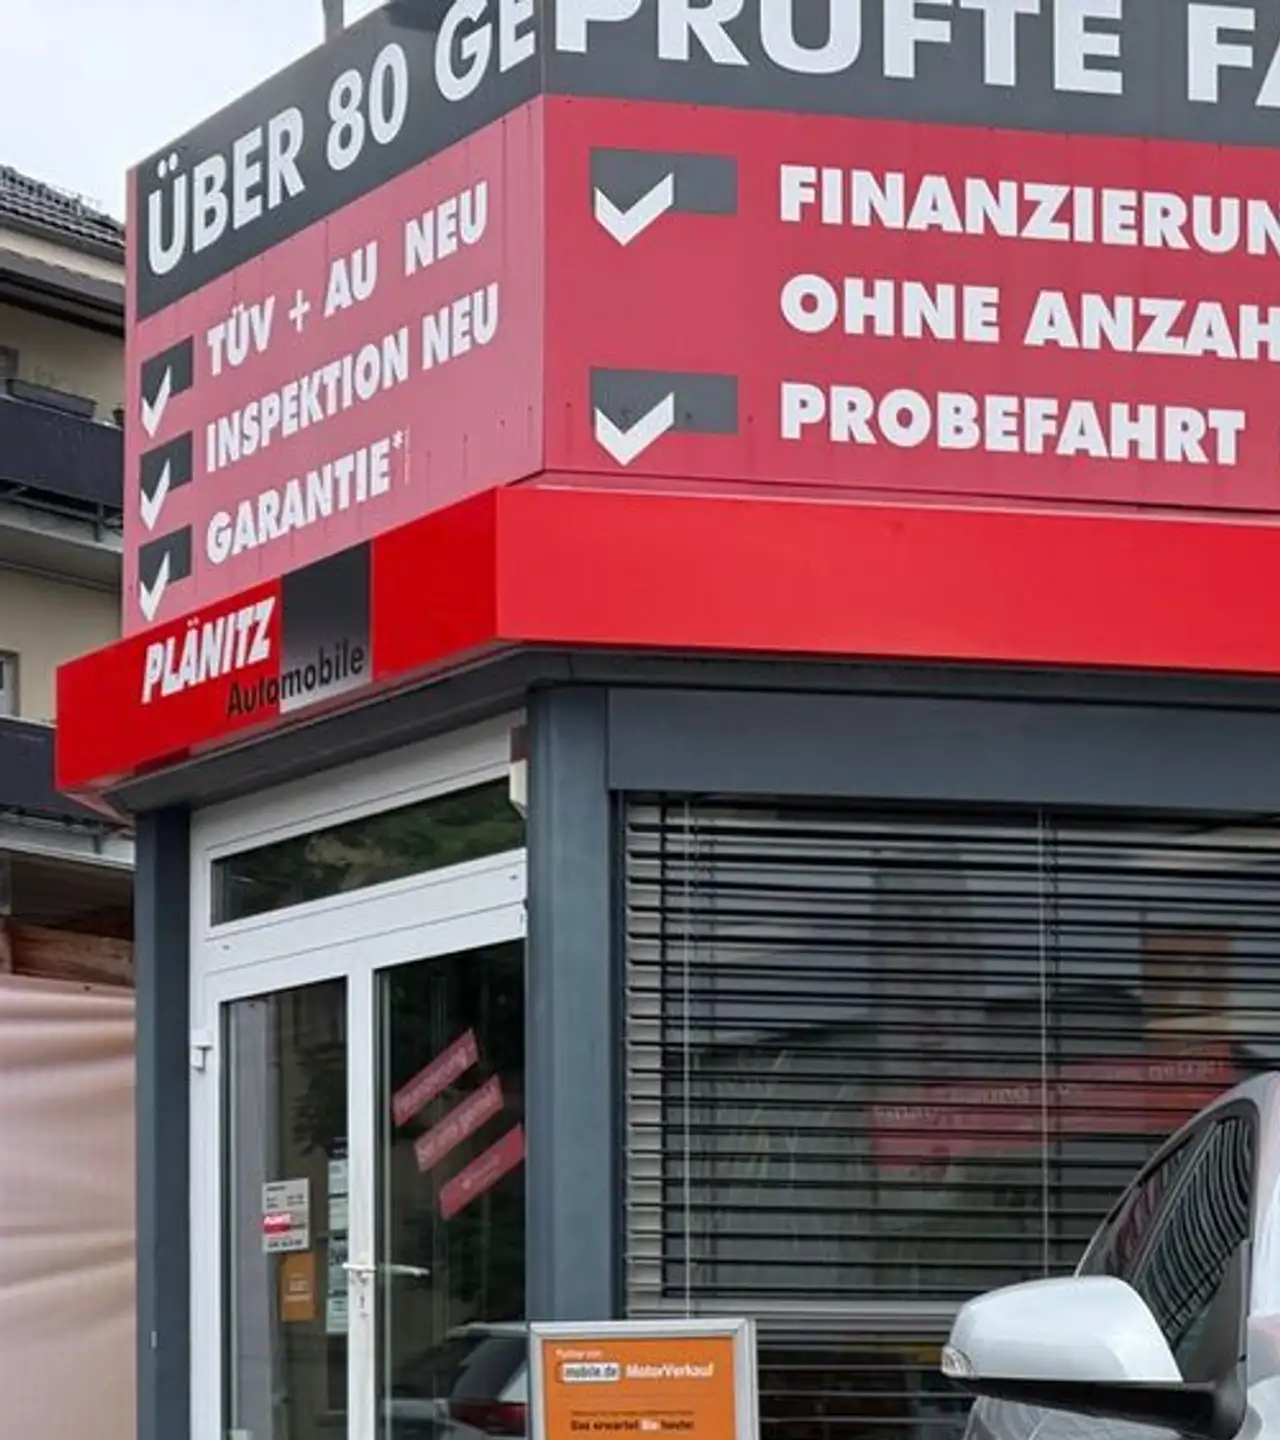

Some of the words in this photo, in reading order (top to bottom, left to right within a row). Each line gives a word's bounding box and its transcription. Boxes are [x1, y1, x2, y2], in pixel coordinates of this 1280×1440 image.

[147, 106, 305, 276] ÜBER
[326, 43, 408, 171] 80
[207, 298, 275, 377] TÜV
[289, 290, 310, 333] +
[323, 242, 379, 319] AU
[405, 182, 488, 278] NEU
[780, 274, 999, 344] OHNE
[206, 328, 408, 472] INSPEKTION
[422, 283, 499, 390] NEU
[780, 382, 1245, 465] PROBEFAHRT
[141, 596, 276, 704] PLÄNITZ
[226, 638, 365, 718] Automobile
[565, 1364, 617, 1378] mobile.de
